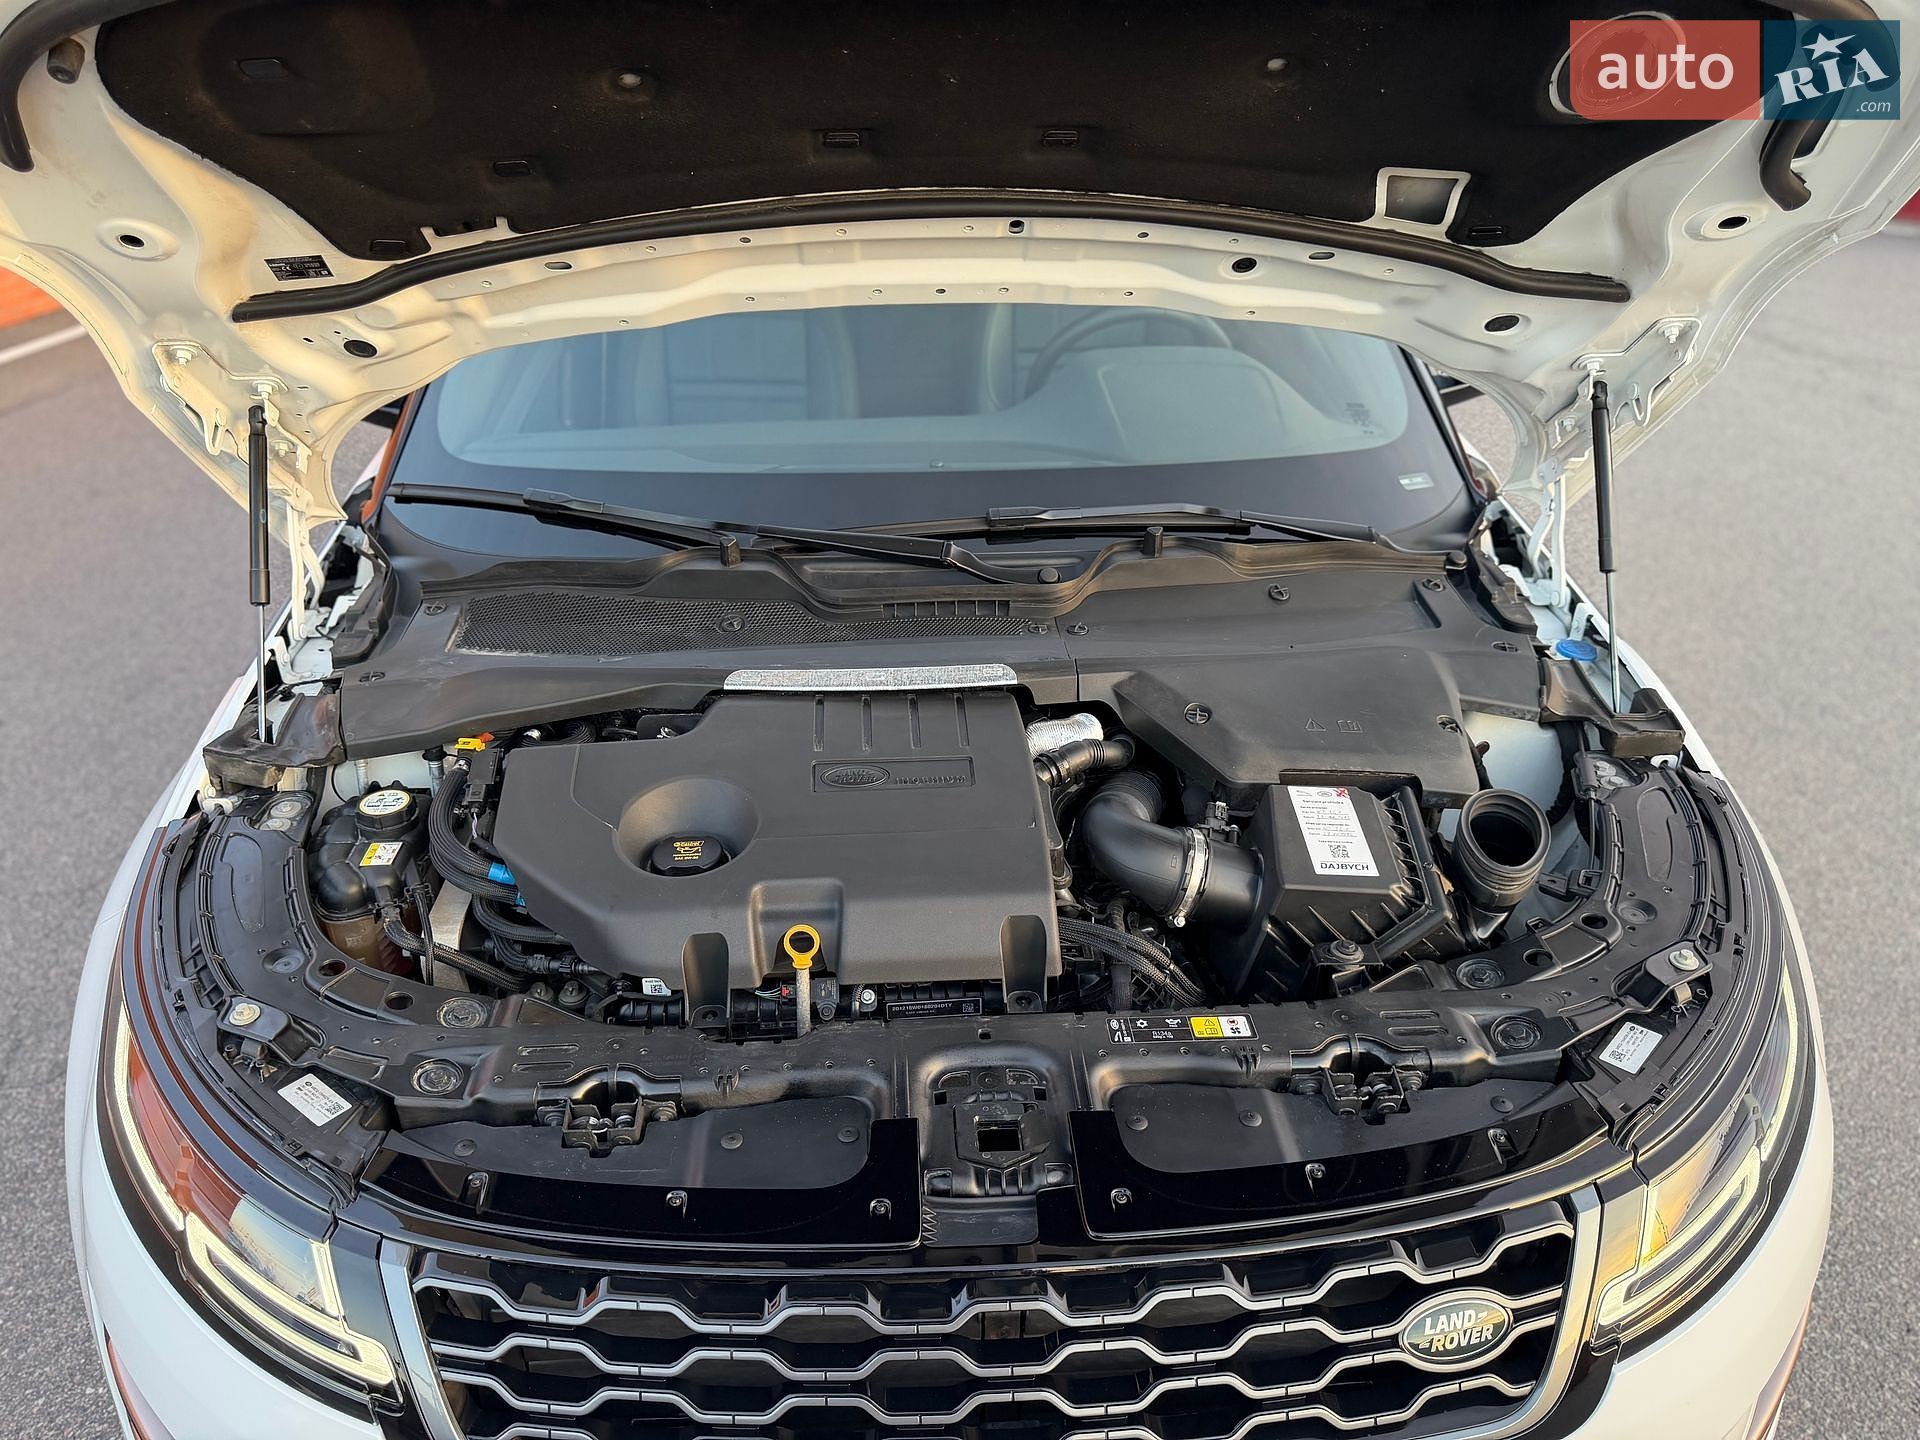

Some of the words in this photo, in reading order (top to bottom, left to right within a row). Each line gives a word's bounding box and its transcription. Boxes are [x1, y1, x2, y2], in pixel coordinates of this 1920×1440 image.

[1320, 862, 1369, 871] DAJBYCH
[1424, 1309, 1476, 1335] LAND
[1431, 1324, 1494, 1352] ROVER
